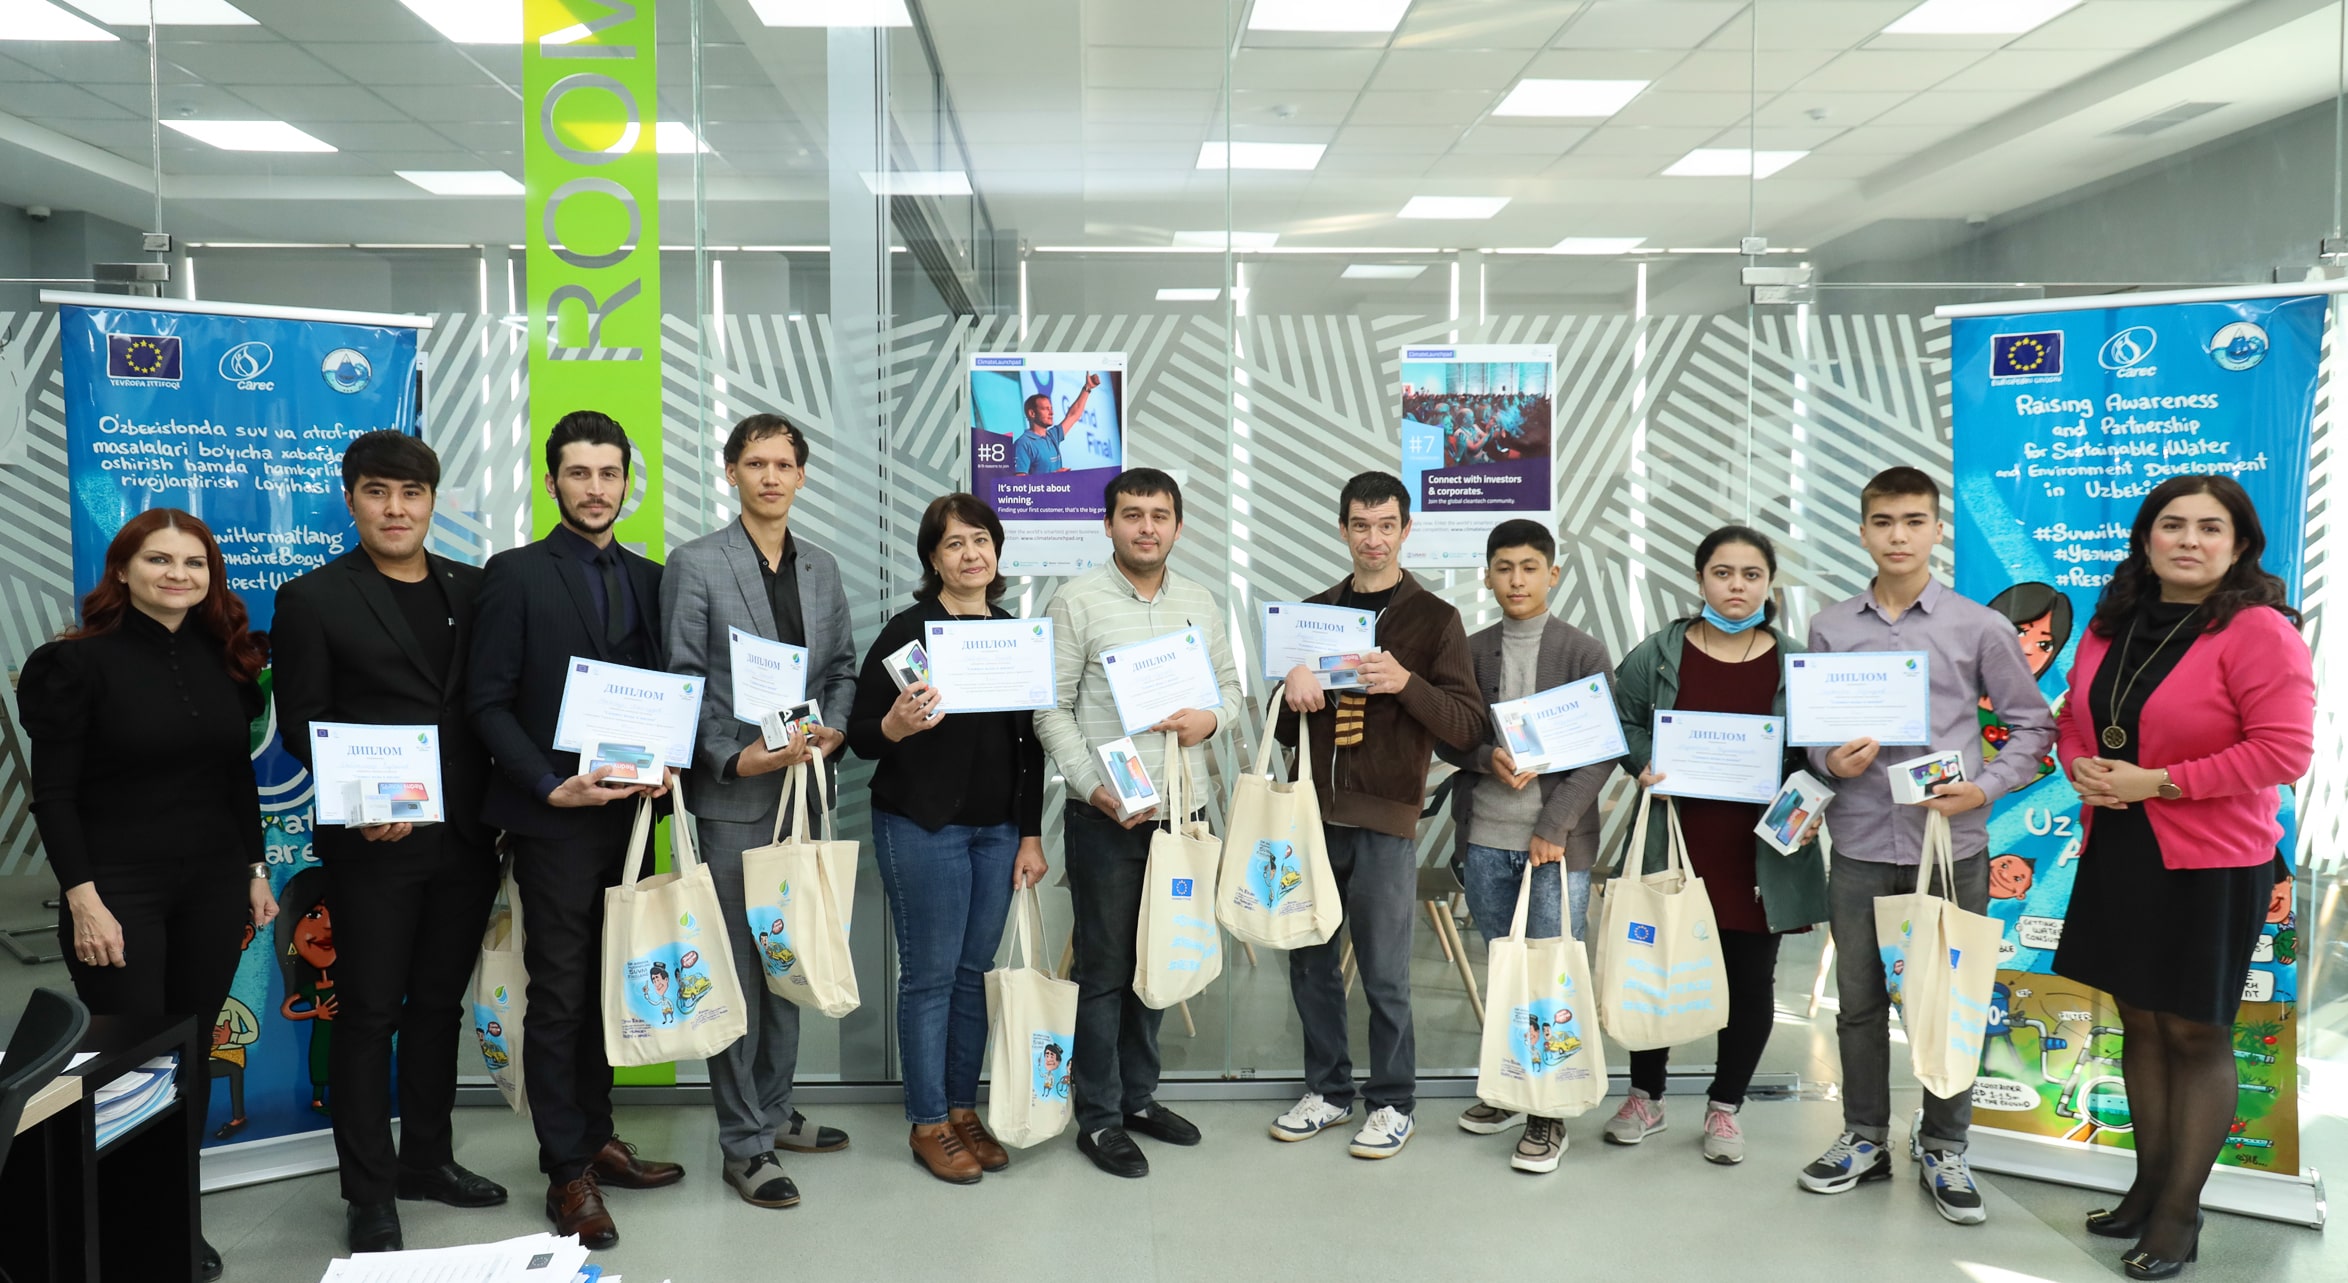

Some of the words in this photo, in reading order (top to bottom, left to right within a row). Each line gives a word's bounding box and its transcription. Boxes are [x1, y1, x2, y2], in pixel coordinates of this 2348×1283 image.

[540, 0, 642, 361] ROOM
[2015, 394, 2094, 418] Raising
[2105, 393, 2219, 412] Awareness
[235, 426, 268, 438] suv
[275, 427, 297, 440] va
[303, 423, 396, 440] atrof-m
[2052, 418, 2088, 438] and
[2101, 415, 2200, 436] Partnership
[92, 440, 189, 457] masalalari
[978, 443, 1005, 462] #8
[1408, 435, 1435, 454] #7
[2024, 442, 2048, 459] for
[2051, 440, 2159, 460] Sustainable
[2167, 438, 2231, 457] Water
[101, 456, 173, 471] oshirish
[184, 458, 248, 474] hamda
[264, 462, 342, 477] hamkorlik
[1995, 463, 2020, 478] and
[2027, 460, 2133, 478] Environment
[121, 473, 239, 492] rivojlantirish
[1428, 475, 1462, 484] Connect
[1463, 475, 1482, 484] with
[1484, 475, 1522, 484] investors
[1013, 485, 1027, 493] not
[1028, 484, 1045, 494] just
[1046, 484, 1071, 493] about
[1428, 487, 1435, 496] &
[1437, 487, 1484, 497] corporates.
[2043, 482, 2065, 497] in
[2085, 479, 2166, 499] Uzbeki
[998, 495, 1034, 506] winning.
[1295, 619, 1345, 633] ДИПЛОМ
[961, 639, 1017, 650] ДИПЛОМ
[1132, 652, 1176, 672] ДИПЛОМ
[1825, 672, 1888, 683] ДИПЛОМ
[604, 683, 665, 701] ДИПЛОМ
[1689, 729, 1746, 742] ДИПЛОМ
[347, 745, 402, 756] ДИПЛОМ
[2025, 807, 2073, 837] Uz
